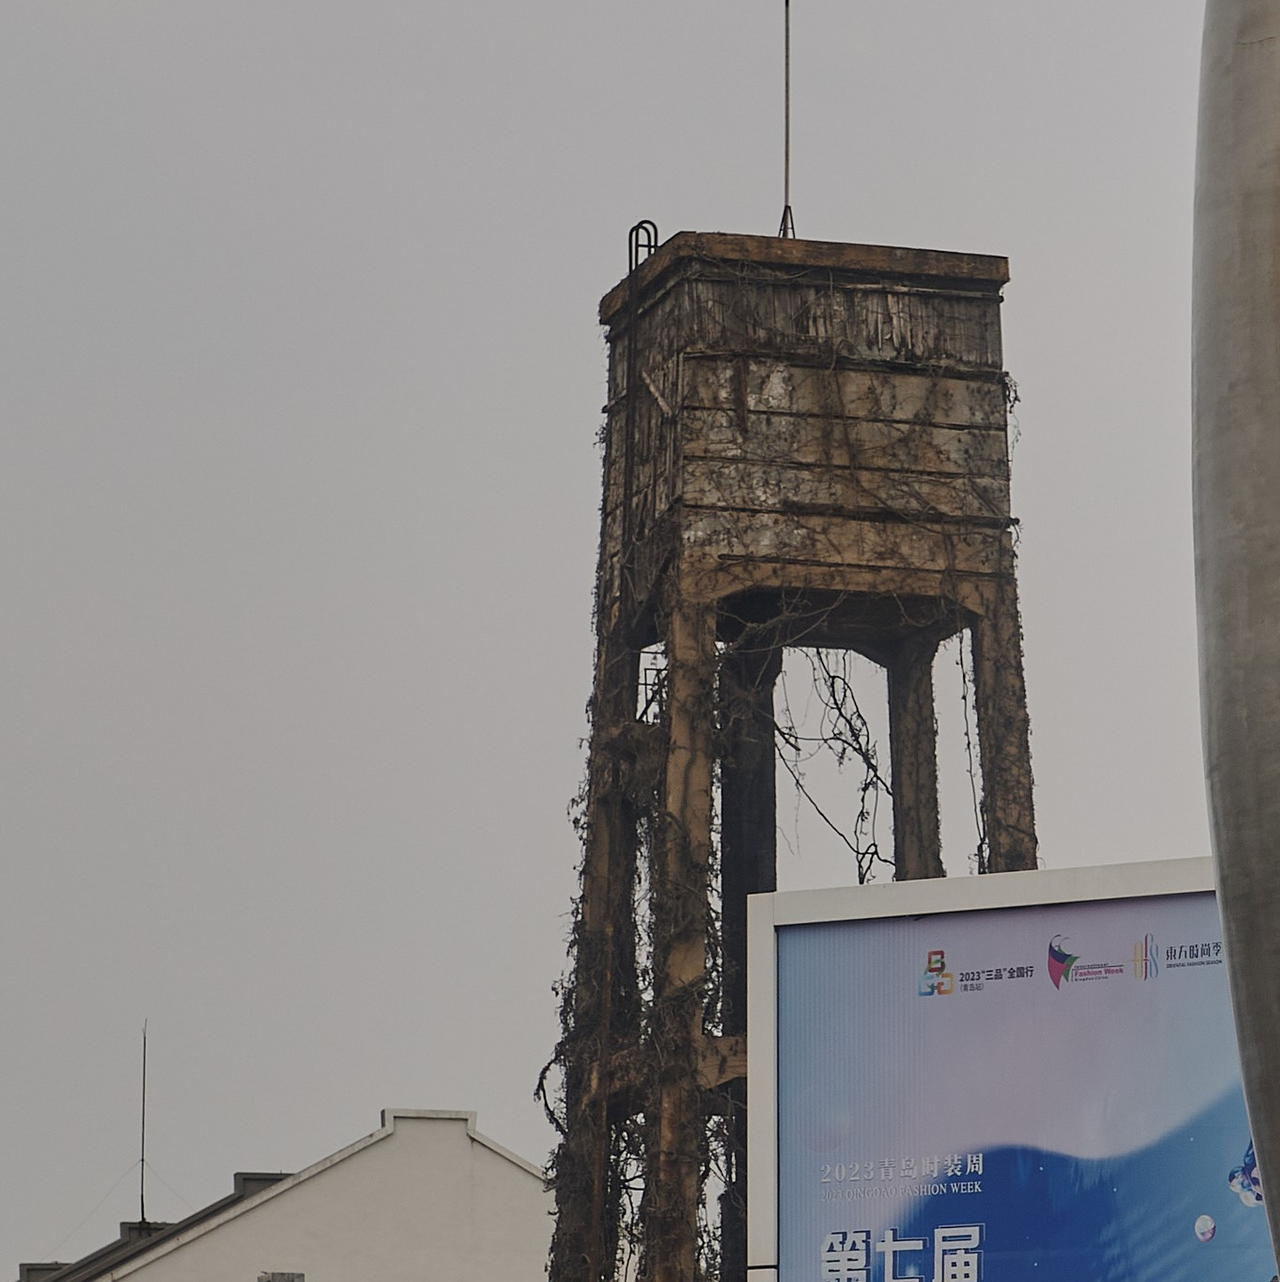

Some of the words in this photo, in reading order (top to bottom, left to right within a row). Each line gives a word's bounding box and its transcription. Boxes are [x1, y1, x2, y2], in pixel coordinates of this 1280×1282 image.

[1075, 969, 1102, 977] Fashion
[1104, 967, 1124, 975] Week
[821, 1152, 984, 1184] 2023青岛时装周
[845, 1186, 896, 1201] QINGDAO
[900, 1183, 947, 1198] FASHION
[950, 1181, 982, 1194] WEEK
